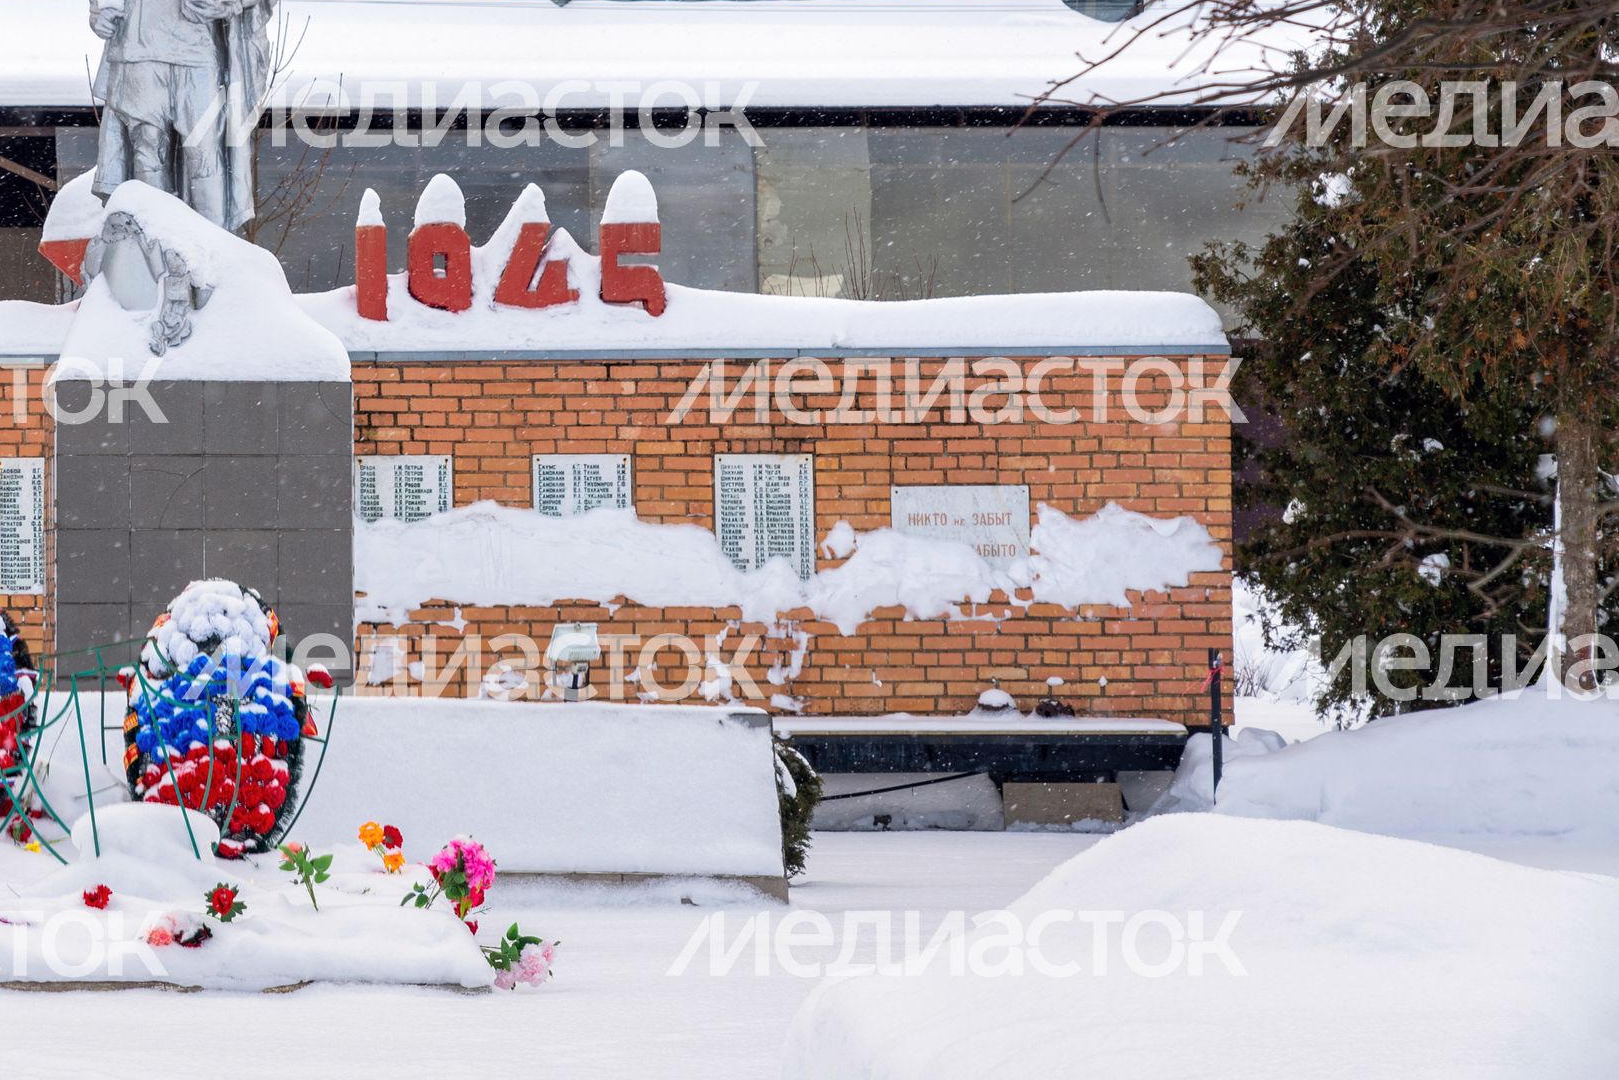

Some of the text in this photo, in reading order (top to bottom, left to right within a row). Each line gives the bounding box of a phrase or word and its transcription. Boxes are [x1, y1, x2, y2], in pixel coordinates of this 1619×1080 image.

[908, 513, 948, 526] НИКТО
[972, 513, 1012, 525] ЗАБЫТ
[976, 544, 1016, 557] АБЫТО
